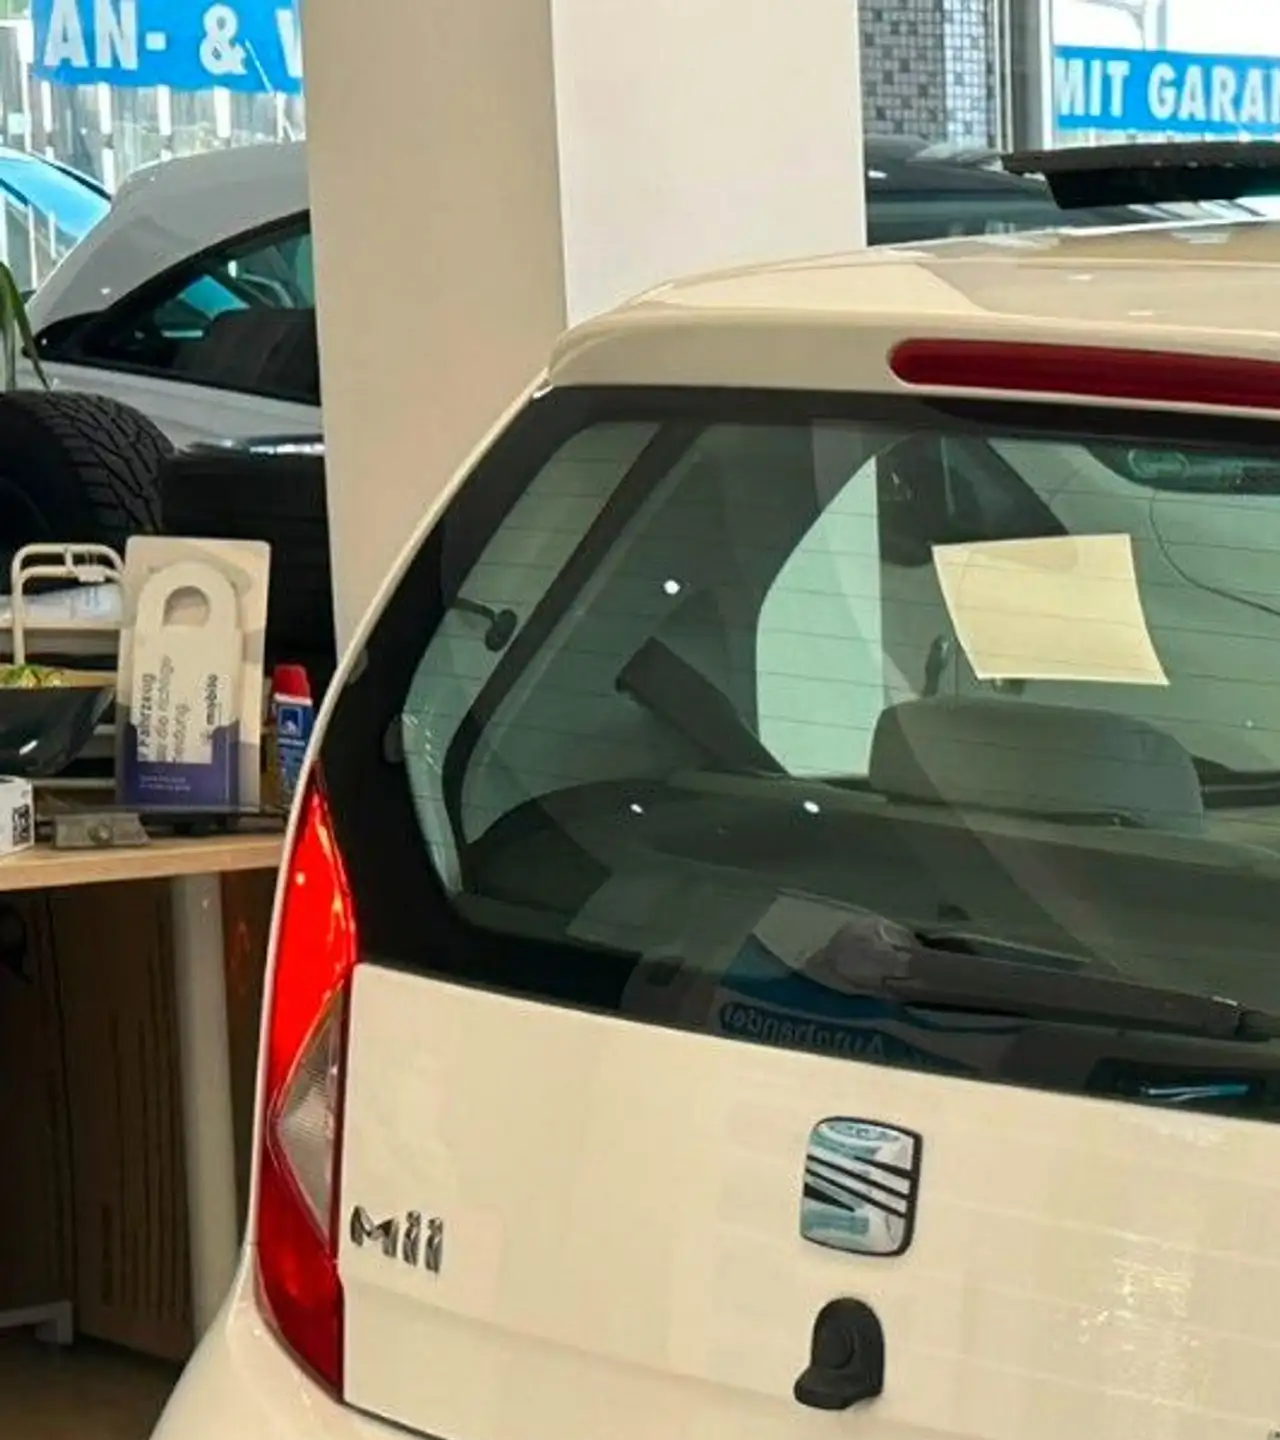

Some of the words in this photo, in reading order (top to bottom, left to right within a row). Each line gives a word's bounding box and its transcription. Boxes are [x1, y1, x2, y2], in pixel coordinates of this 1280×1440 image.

[199, 3, 248, 76] &
[1054, 57, 1131, 118] MIT
[350, 1205, 443, 1274] Mii
